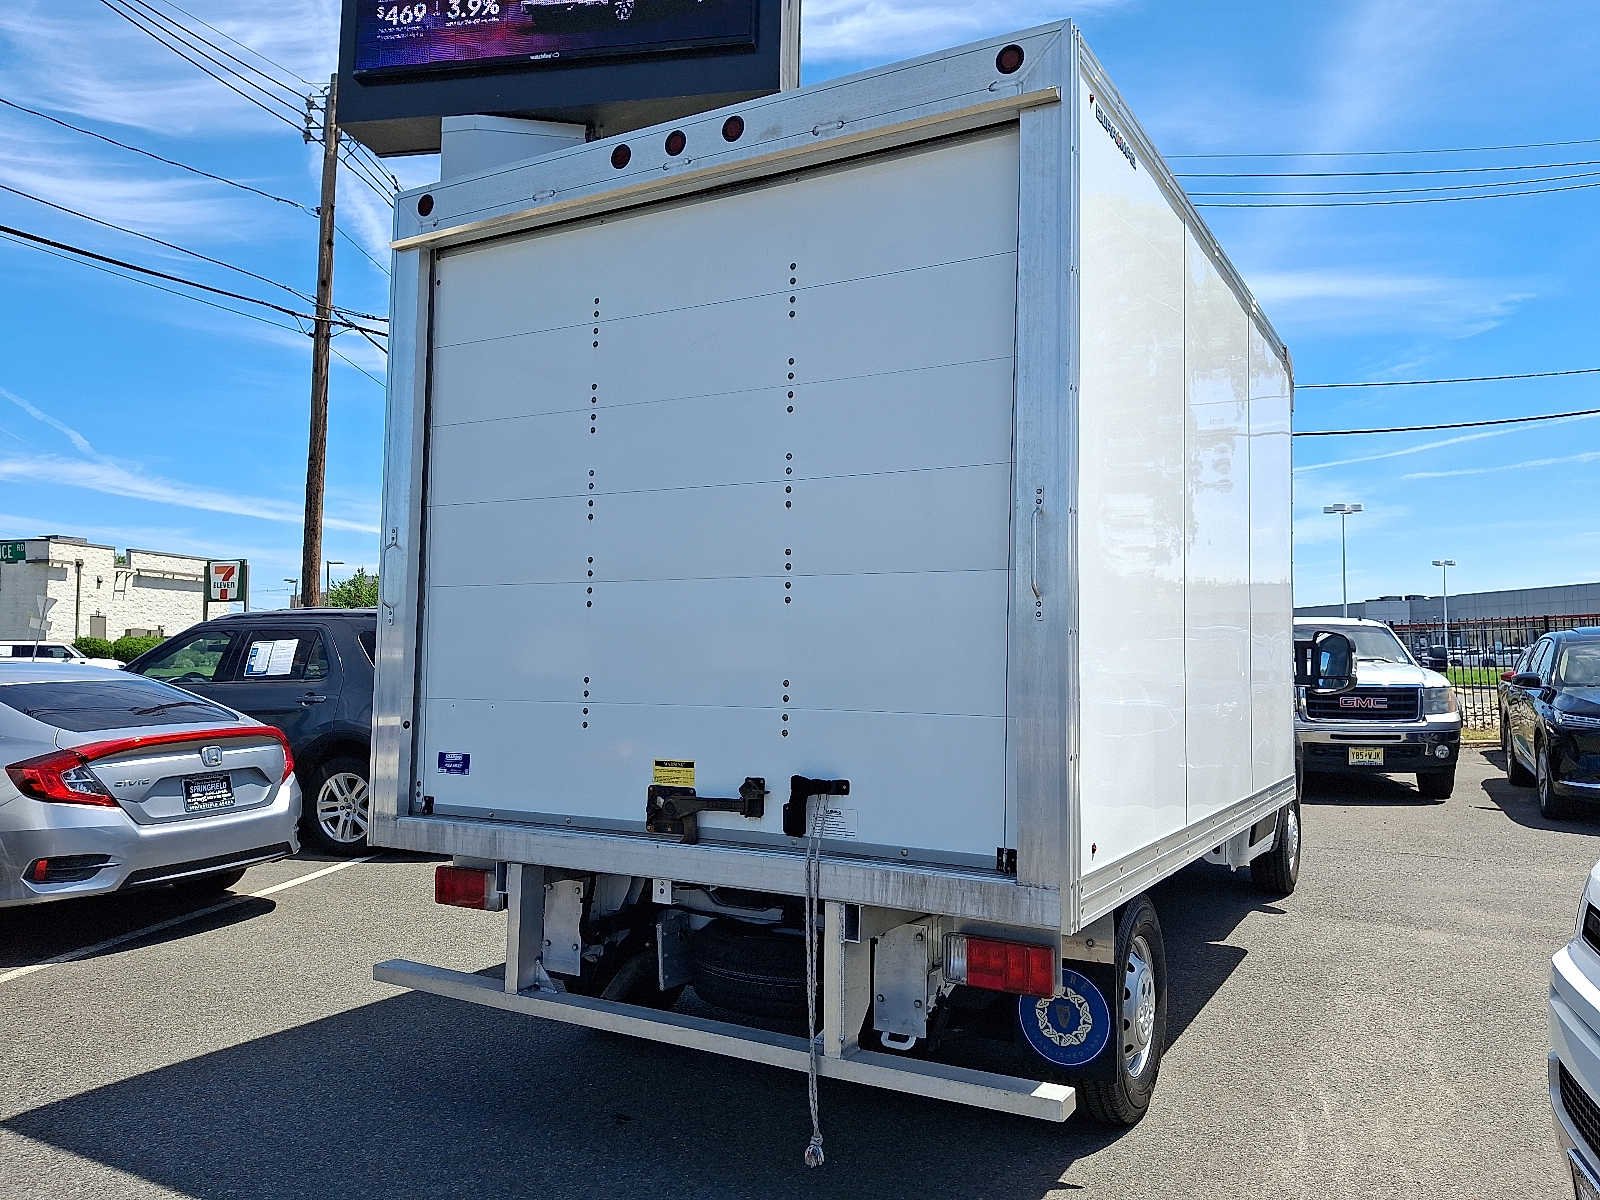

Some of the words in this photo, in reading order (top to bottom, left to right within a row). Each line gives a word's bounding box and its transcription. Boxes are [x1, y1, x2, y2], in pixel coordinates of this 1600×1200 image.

[377, 3, 427, 25] $469
[0, 545, 13, 559] CE
[1340, 697, 1387, 708] GMC
[189, 781, 227, 794] SPRINGFIELD
